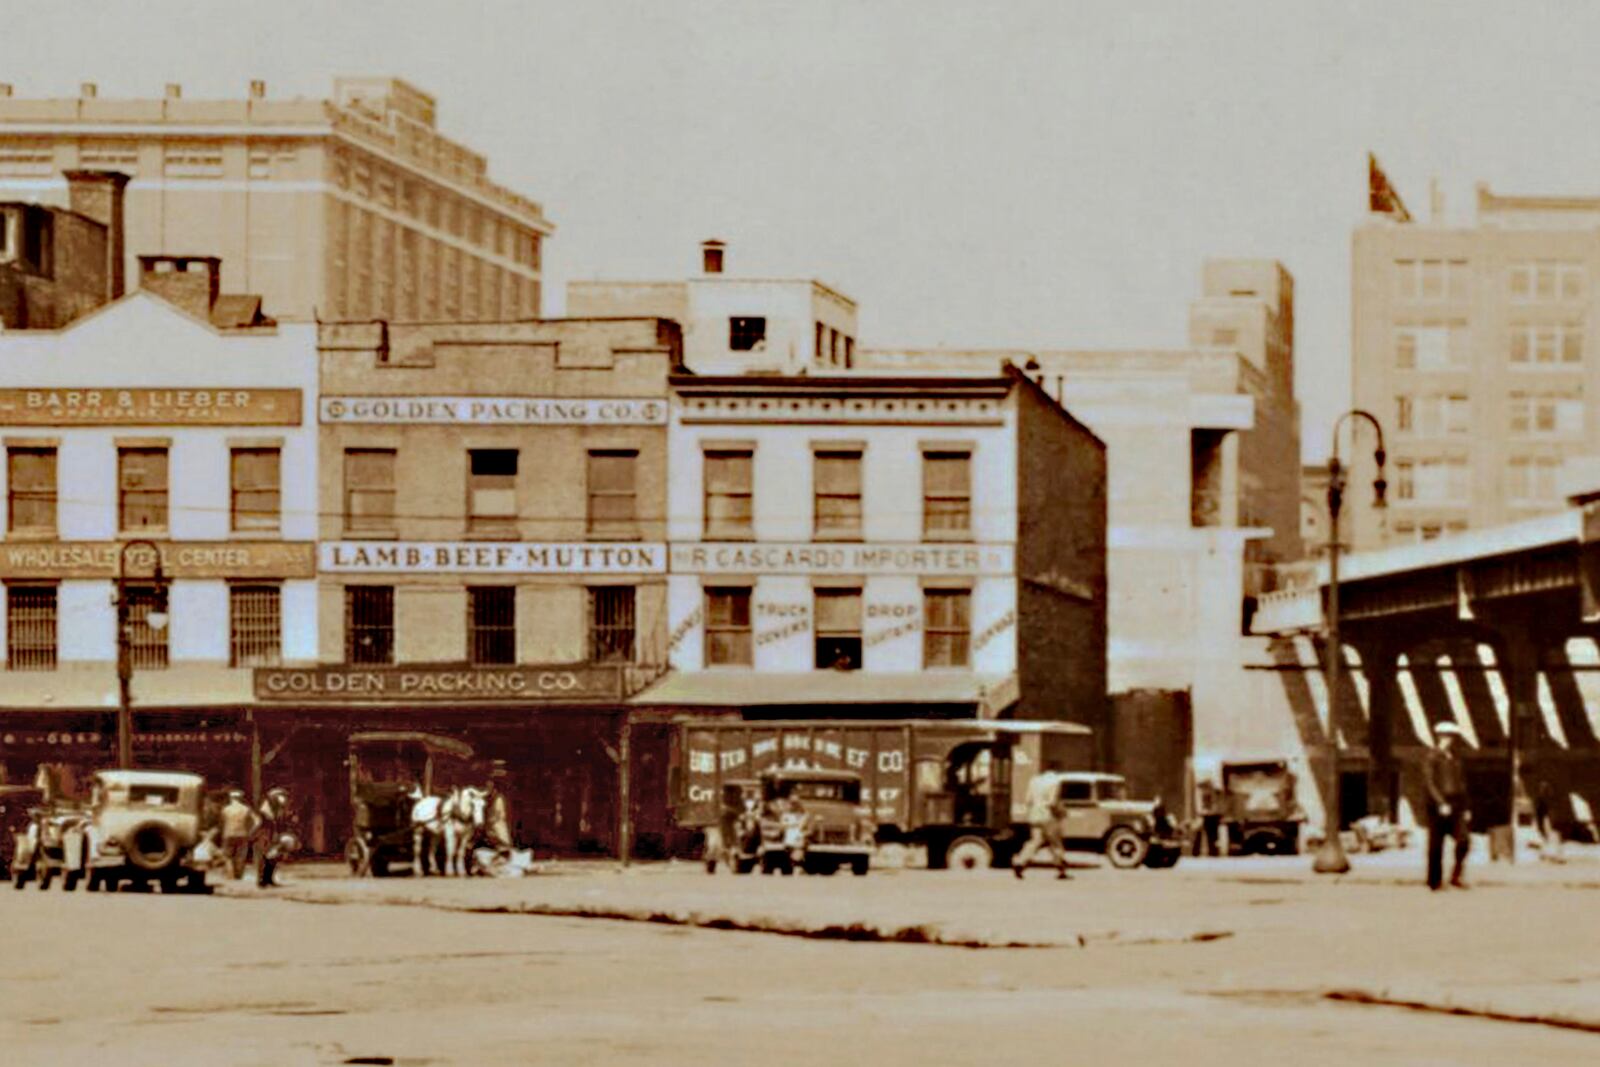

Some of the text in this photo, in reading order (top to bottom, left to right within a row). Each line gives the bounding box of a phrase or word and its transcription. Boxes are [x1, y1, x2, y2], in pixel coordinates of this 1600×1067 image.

[26, 391, 250, 408] BARR & LIEBER
[353, 401, 456, 418] GOLDEN
[472, 401, 586, 418] PACKING
[8, 547, 115, 567] WHOLESALE
[179, 549, 249, 566] CENTER
[716, 549, 844, 567] CASCARDO
[854, 549, 978, 568] IMPORTER
[267, 673, 385, 692] GOLDEN
[401, 673, 525, 692] PACKING
